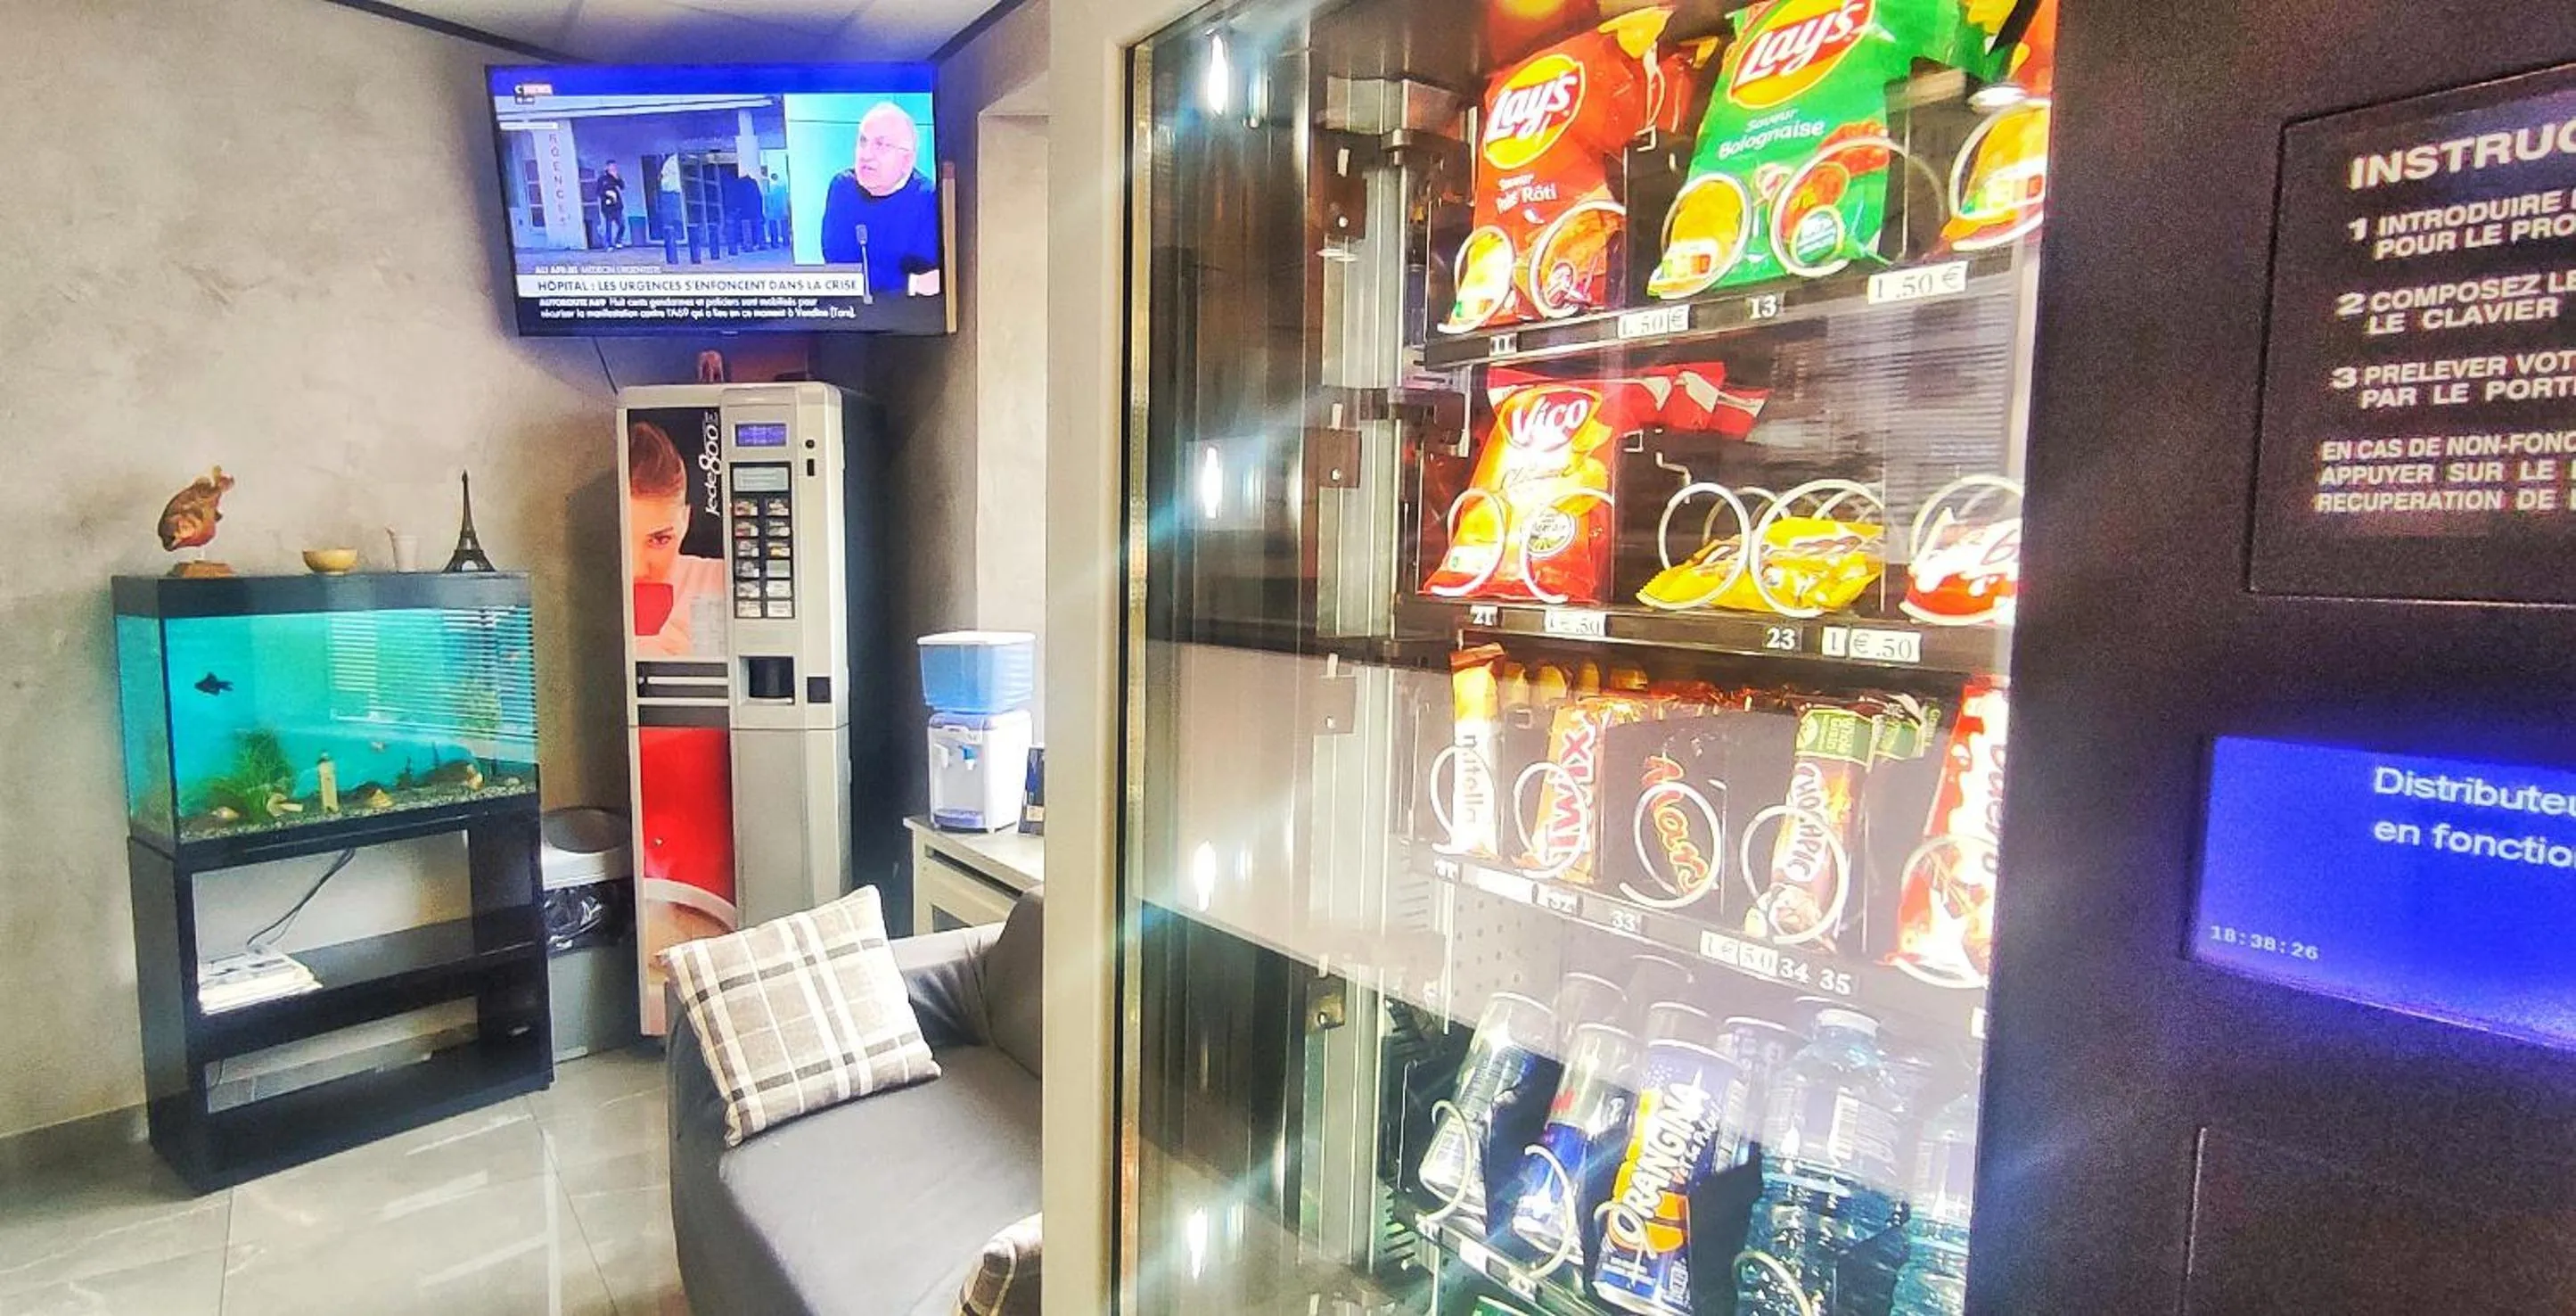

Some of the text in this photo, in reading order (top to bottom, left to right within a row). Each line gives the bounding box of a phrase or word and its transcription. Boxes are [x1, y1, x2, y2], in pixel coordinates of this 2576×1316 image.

[1735, 0, 1866, 87] Lay's
[1486, 74, 1579, 143] Lay's
[1746, 109, 1799, 134] Saveur
[1719, 120, 1826, 160] Bolognaise
[1522, 183, 1557, 203] Rôti
[2349, 218, 2367, 242] 1
[2377, 189, 2563, 236] INTRODUIRE
[2375, 232, 2456, 260] POUR
[2464, 224, 2502, 249] LE
[598, 280, 616, 292] LES
[619, 280, 681, 292] URGENCES
[685, 280, 766, 291] S'ENFONCENT
[770, 280, 804, 291] DANS
[808, 280, 822, 290] LA
[824, 280, 857, 290] CRISE
[2336, 292, 2367, 317] 2
[2370, 274, 2541, 312] COMPOSEZ
[1748, 295, 1776, 320] 13
[2367, 296, 2559, 336] LE CLAVIER
[2331, 366, 2358, 390] 3
[2364, 355, 2506, 388] PRELEVER
[2360, 375, 2576, 409] PAR LE PORT
[1512, 396, 1587, 447] Vico
[2321, 440, 2352, 462] EN
[2354, 438, 2401, 460] CAS
[2408, 436, 2441, 457] DE
[2318, 463, 2435, 488] APPUYER
[2446, 461, 2503, 483] SUR
[2520, 458, 2556, 481] LE
[2317, 489, 2503, 514] RECUPERATION
[2516, 488, 2556, 510] DE
[1766, 627, 1795, 651] 23
[2374, 820, 2576, 868] en fonctio
[1611, 910, 1636, 932] 33
[2211, 925, 2319, 960] 18:38:26
[1779, 957, 1852, 996] 34 35
[1609, 1081, 1701, 1246] ORANGINA
